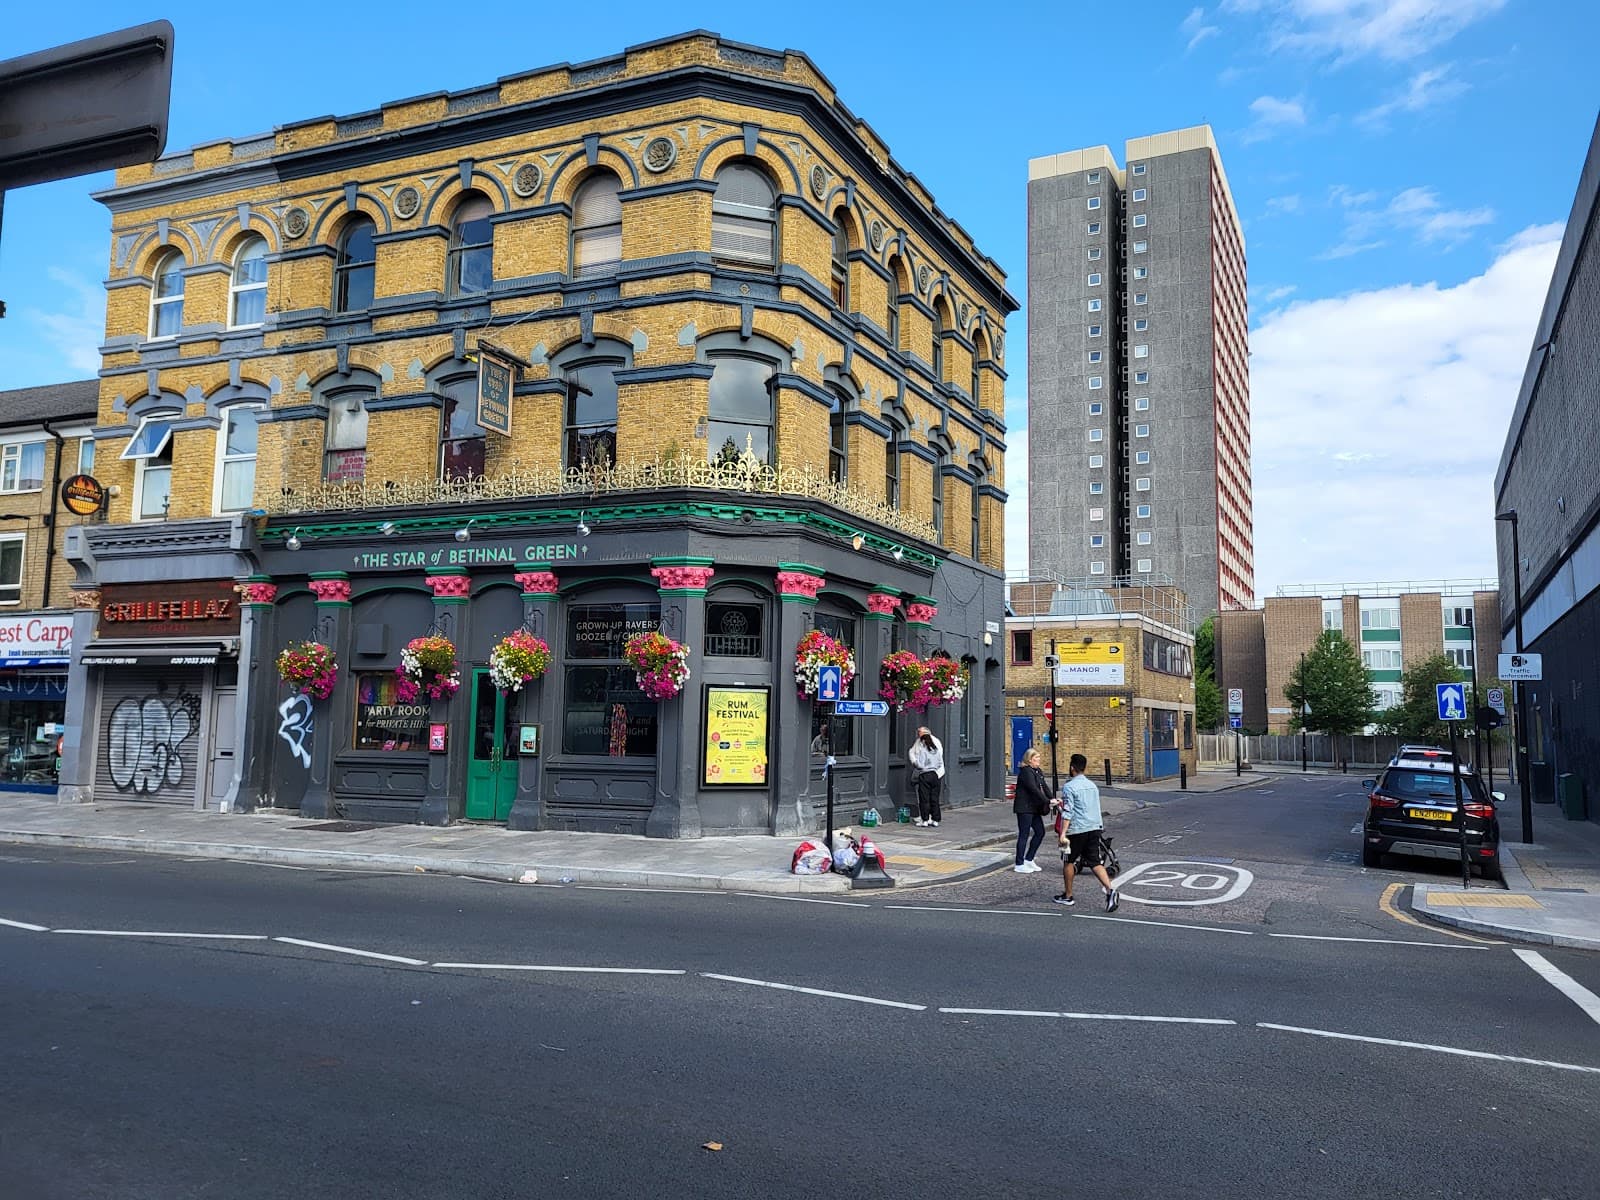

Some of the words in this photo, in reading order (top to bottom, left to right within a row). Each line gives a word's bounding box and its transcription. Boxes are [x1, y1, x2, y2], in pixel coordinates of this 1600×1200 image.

[362, 553, 388, 567] THE
[392, 551, 426, 566] STAR
[431, 549, 444, 565] of
[449, 547, 516, 564] BETHNAL
[524, 544, 578, 561] GREEN
[103, 599, 232, 621] GRILLFELLAZ
[625, 620, 658, 629] RAVERS
[727, 700, 748, 709] RUM
[364, 705, 395, 716] PARTY
[398, 705, 432, 716] ROOM
[716, 710, 760, 719] FESTIVAL
[365, 719, 376, 729] for
[376, 719, 409, 728] PRIVATE
[1132, 870, 1230, 890] 20
